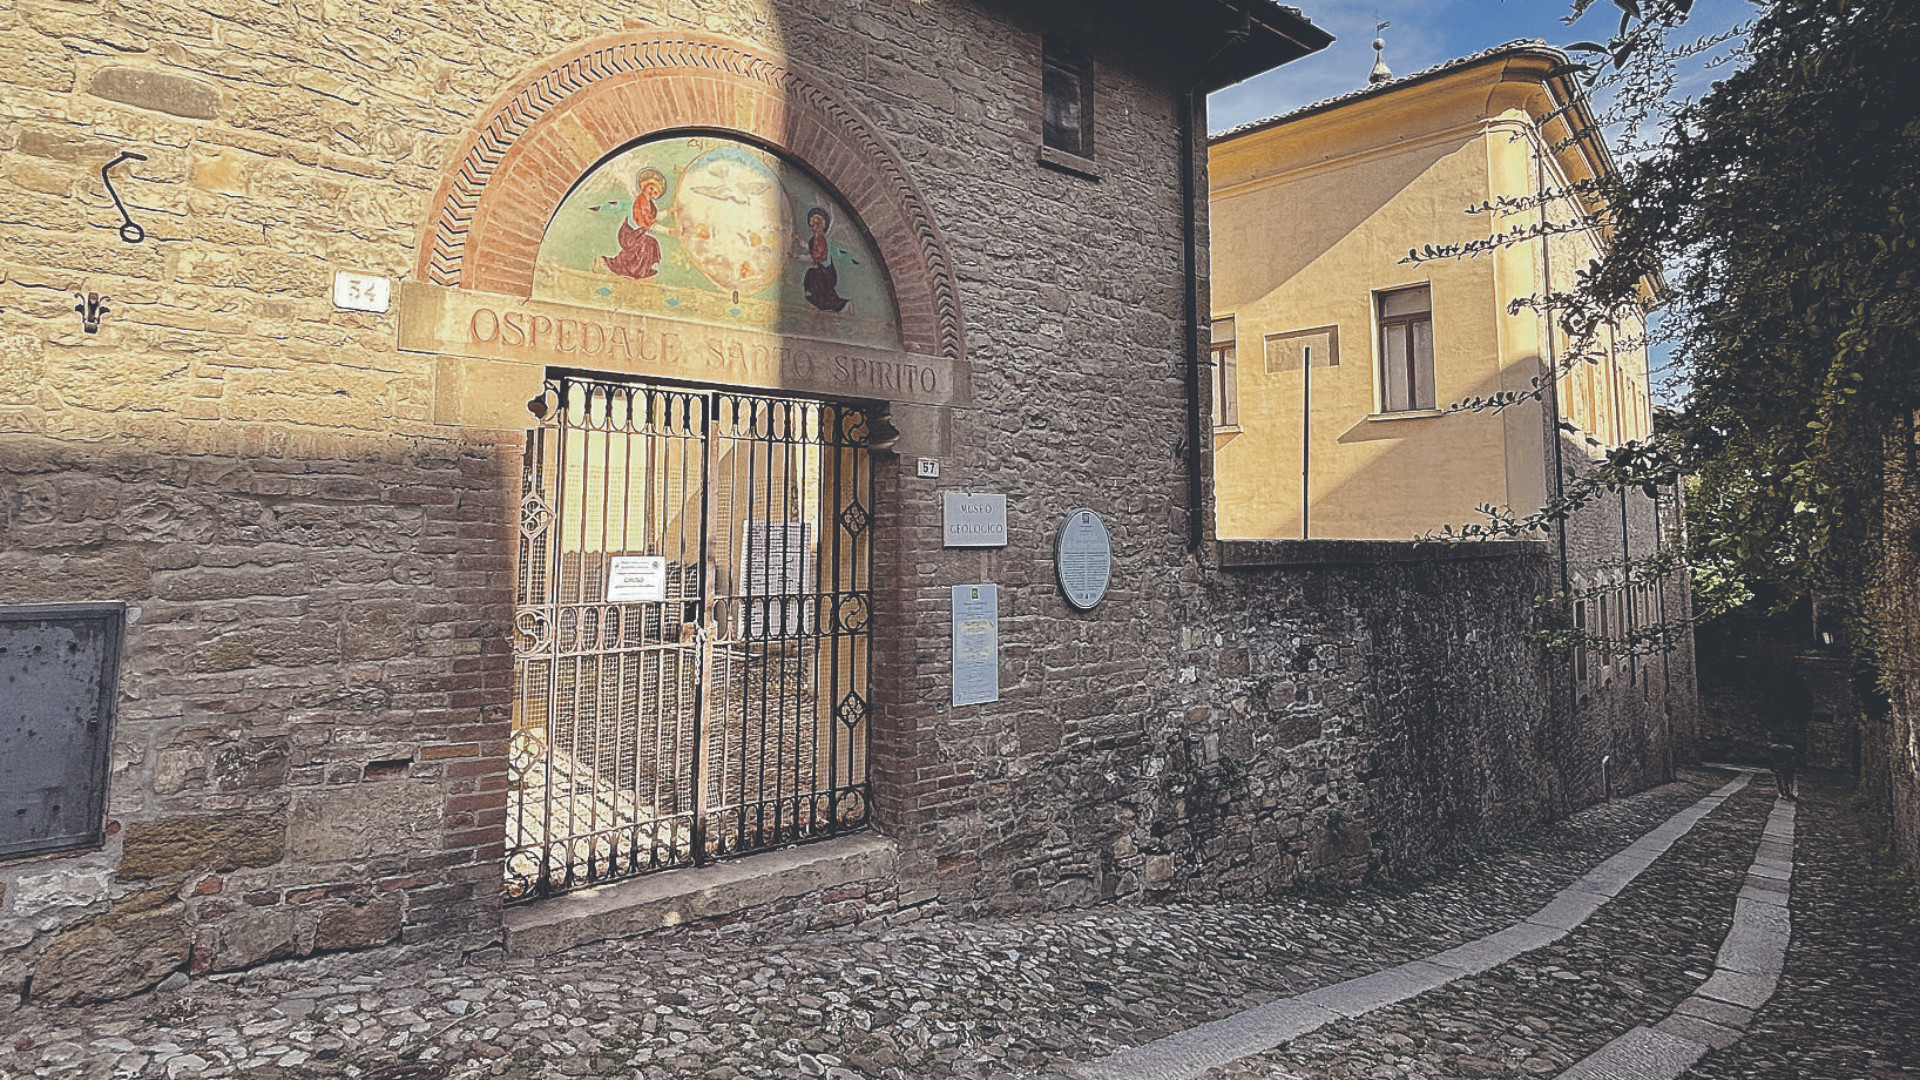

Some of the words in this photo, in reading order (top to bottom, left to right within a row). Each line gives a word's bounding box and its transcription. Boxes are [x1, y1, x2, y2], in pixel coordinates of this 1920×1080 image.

[348, 279, 377, 303] 54
[470, 307, 681, 364] OSPEDALE
[704, 337, 812, 380] SANTO
[833, 356, 937, 394] SPIRITO
[923, 461, 935, 474] 57
[960, 504, 993, 514] MUSEO
[950, 524, 1003, 534] GEOLOGICO
